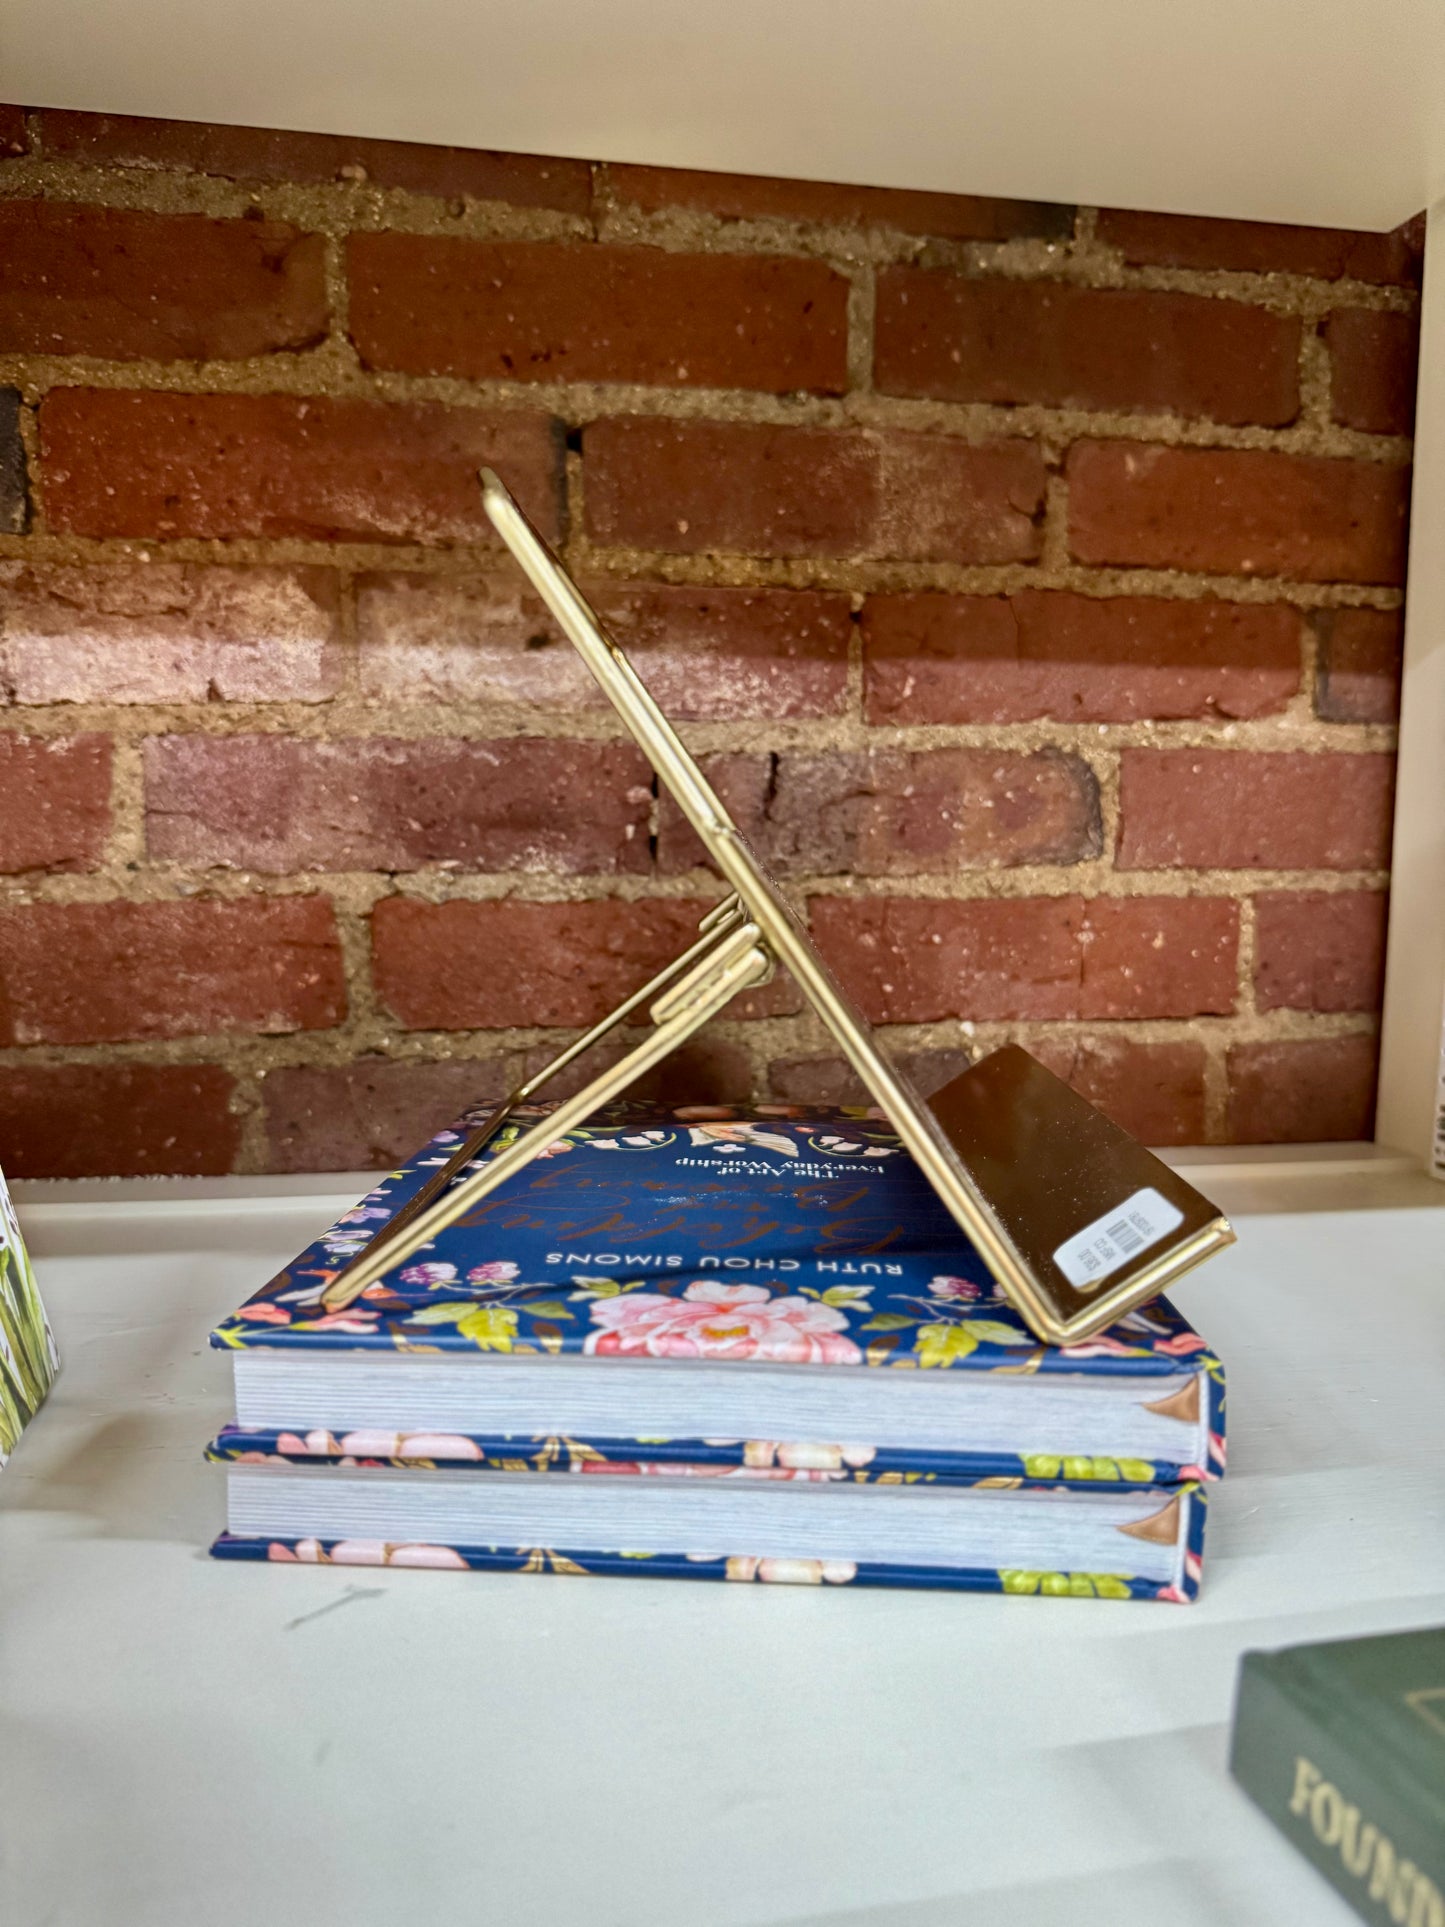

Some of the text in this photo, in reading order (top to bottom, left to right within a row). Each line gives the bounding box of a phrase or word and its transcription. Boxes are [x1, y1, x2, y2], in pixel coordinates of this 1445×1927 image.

[675, 1157, 884, 1174] Everyday Worship
[717, 1166, 840, 1179] The Art of
[545, 1252, 903, 1275] RUTH CHOU SIMONS
